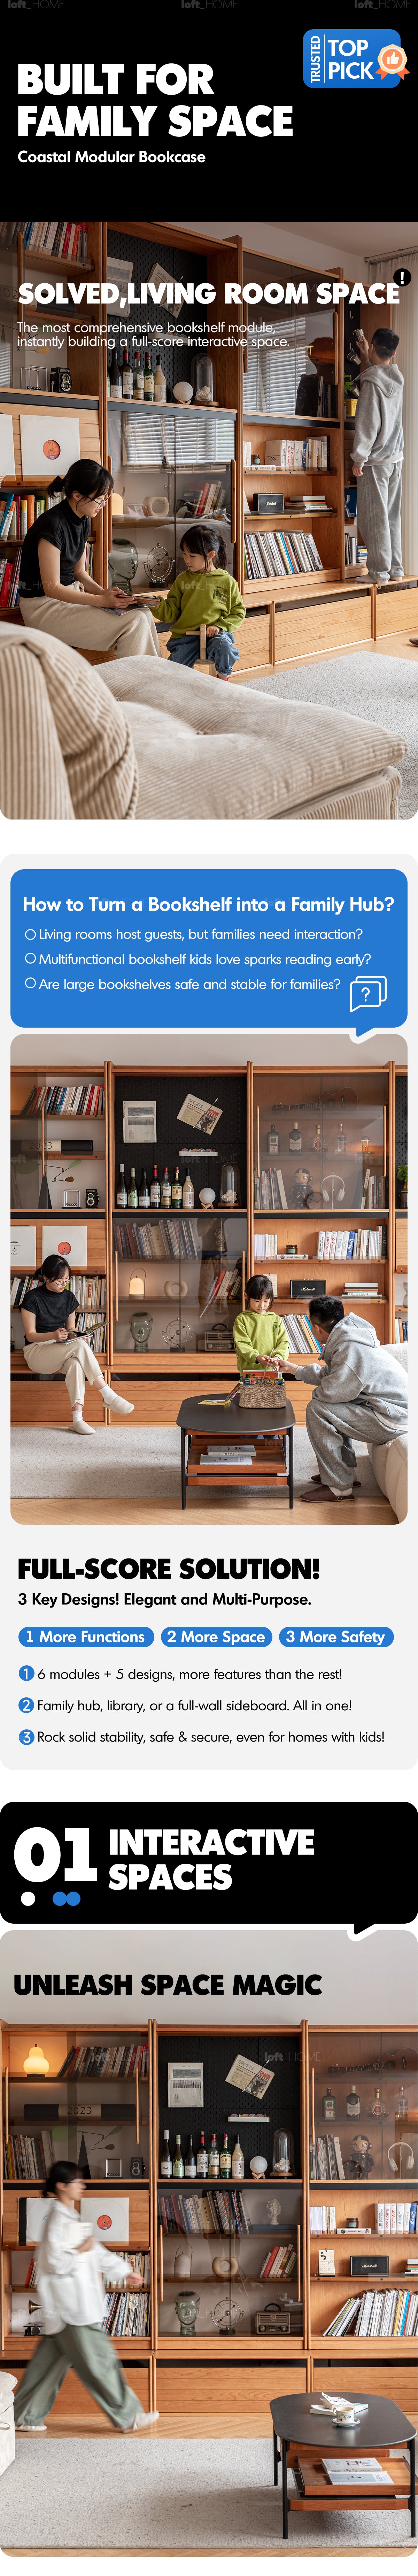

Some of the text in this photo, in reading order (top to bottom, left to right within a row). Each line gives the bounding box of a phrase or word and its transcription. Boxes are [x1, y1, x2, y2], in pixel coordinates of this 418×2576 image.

[156, 269, 170, 283] SPORTS
[188, 1099, 203, 1108] SPORTS
[238, 2060, 254, 2071] SPORTS
